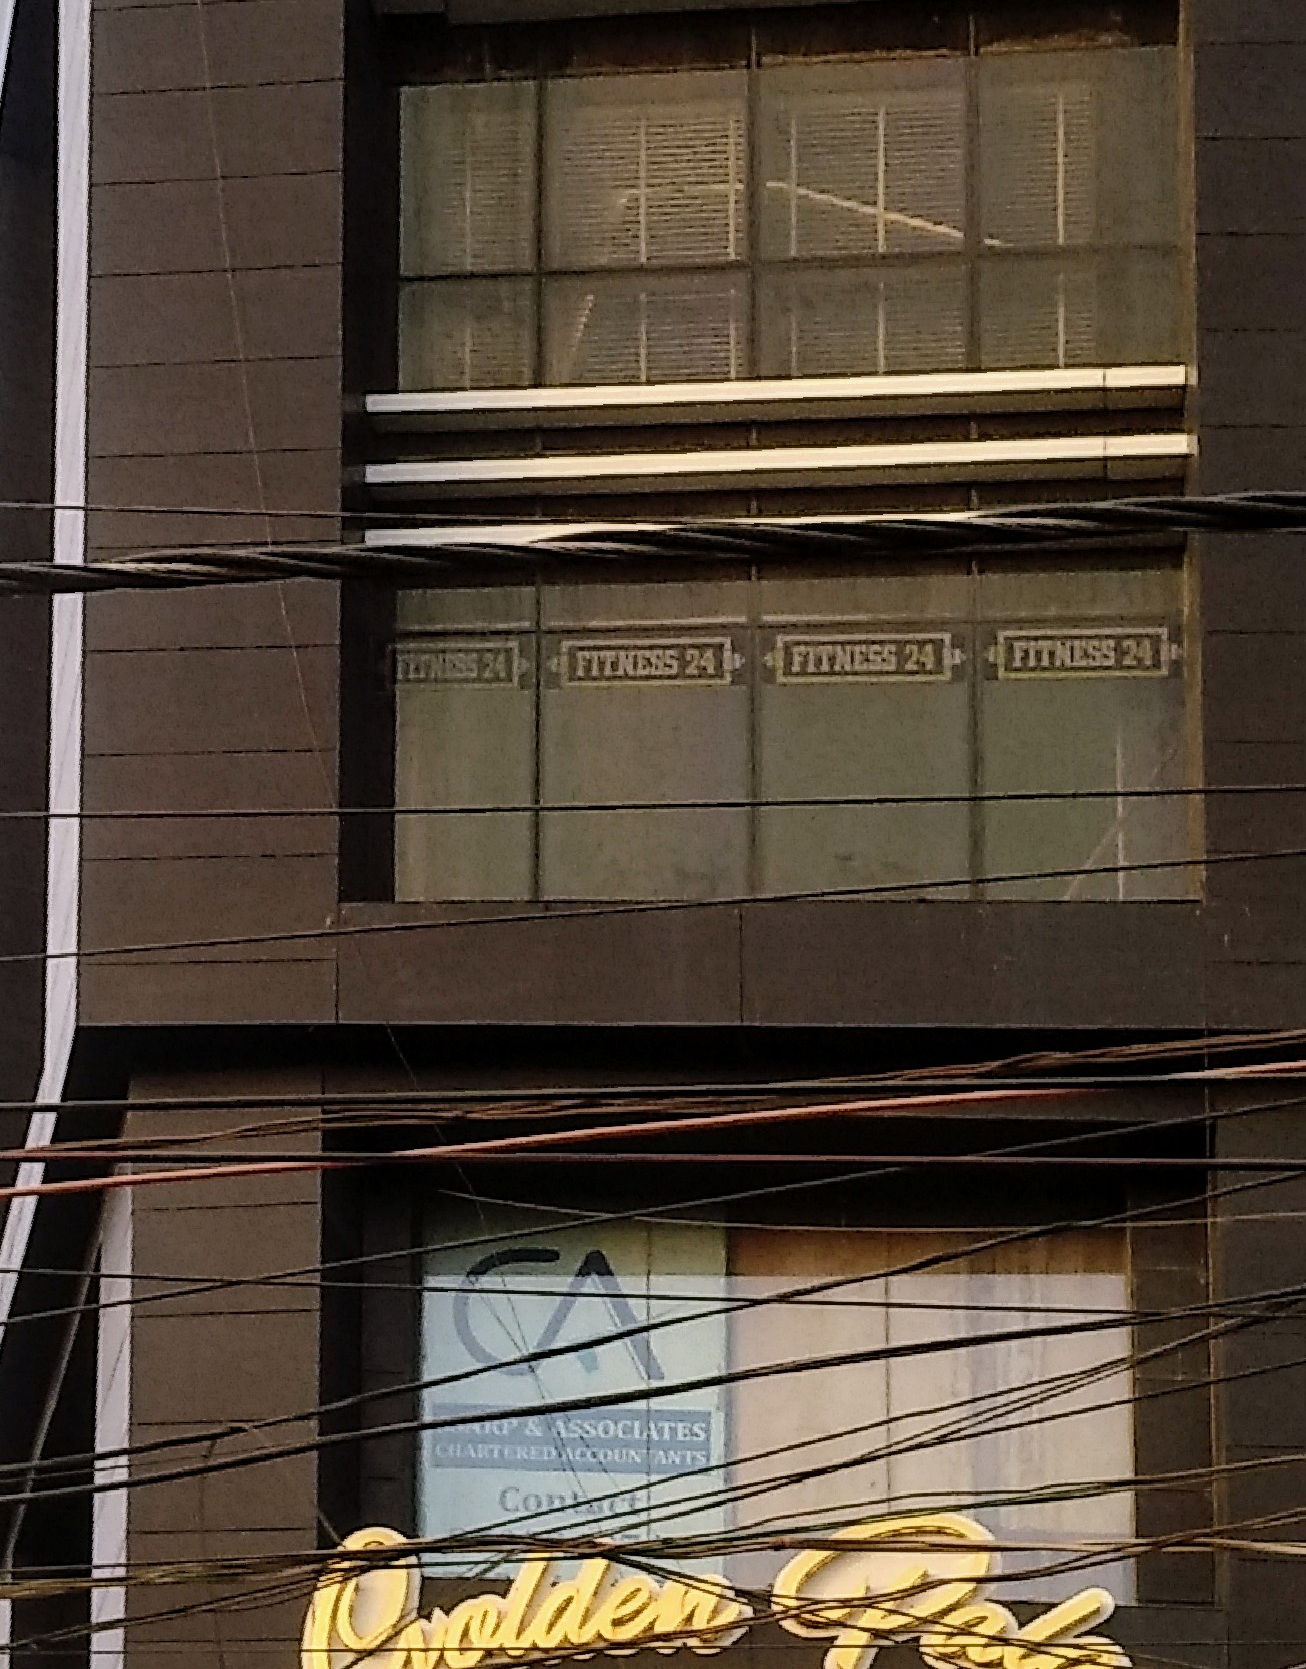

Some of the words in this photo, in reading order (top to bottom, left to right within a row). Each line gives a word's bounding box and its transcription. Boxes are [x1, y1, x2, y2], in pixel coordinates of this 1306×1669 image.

[482, 651, 507, 679] 24
[575, 648, 679, 677] FITNESS
[684, 648, 716, 676] 24
[791, 644, 898, 673] FITNESS
[903, 643, 935, 671] 24
[1012, 638, 1117, 668] FITNESS
[1121, 638, 1153, 667] 24
[452, 1246, 665, 1382] CA
[524, 1415, 544, 1438] &
[552, 1418, 707, 1442] ASSOCIATES
[434, 1443, 556, 1461] CHARTERED
